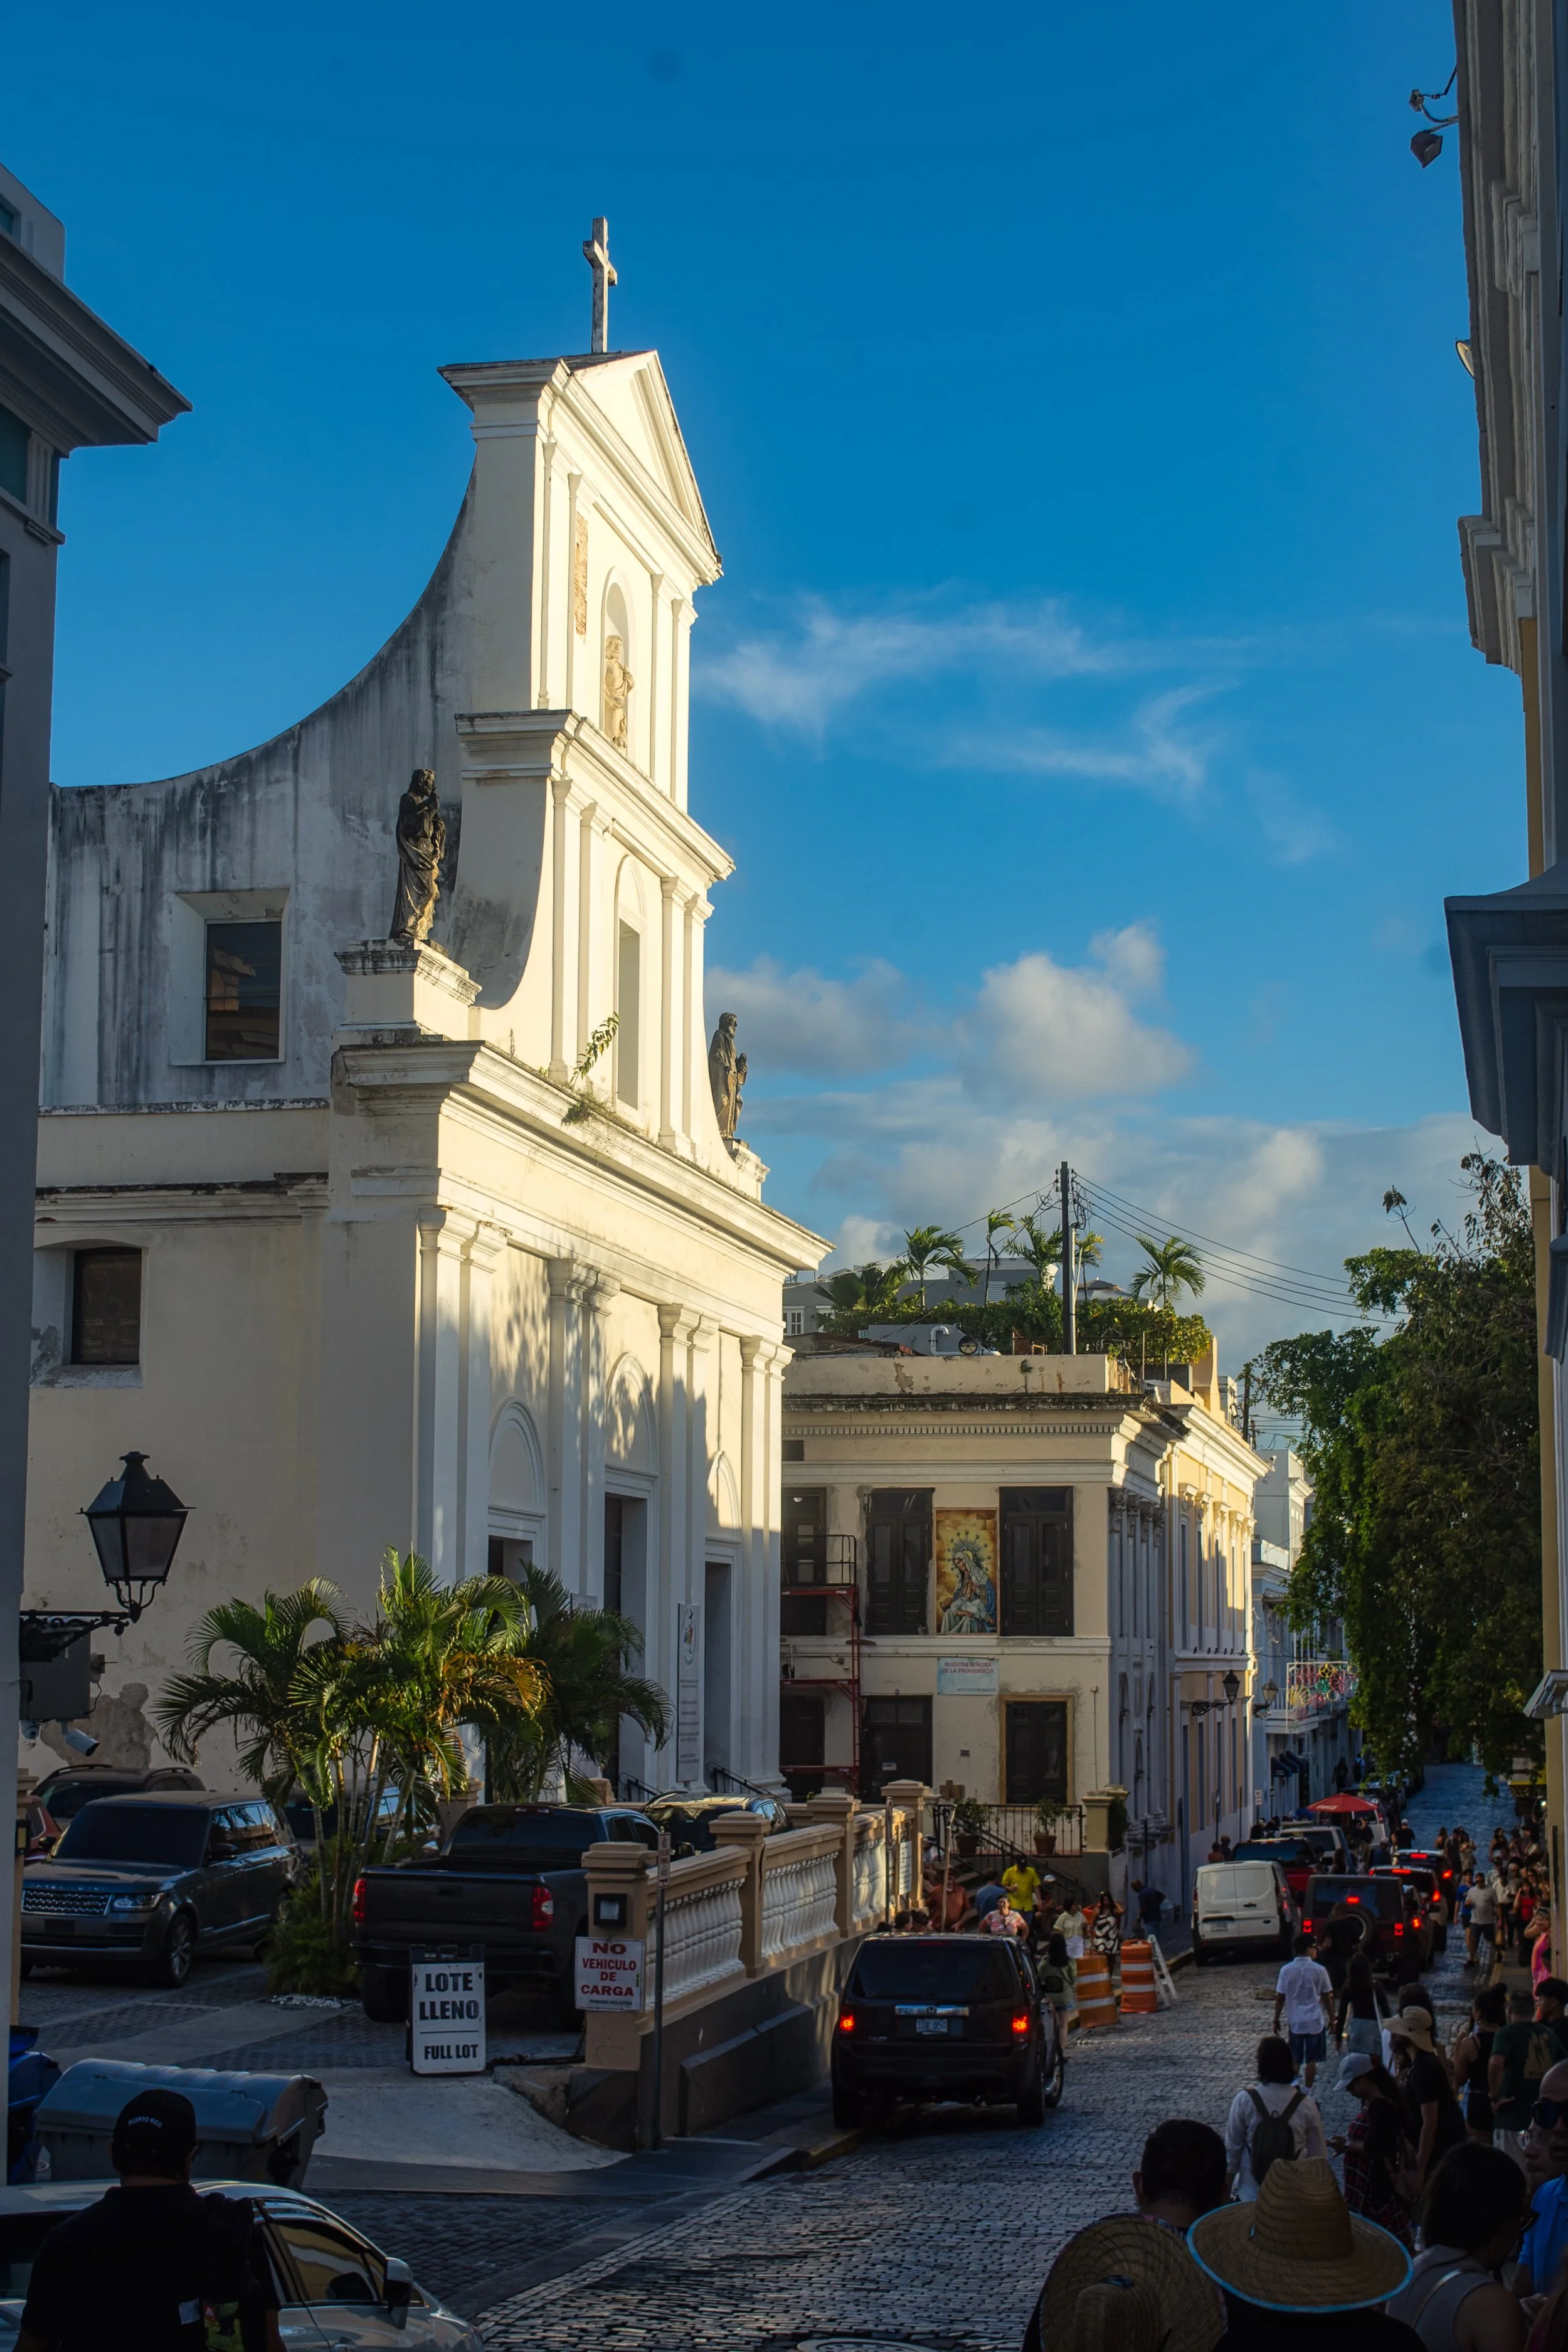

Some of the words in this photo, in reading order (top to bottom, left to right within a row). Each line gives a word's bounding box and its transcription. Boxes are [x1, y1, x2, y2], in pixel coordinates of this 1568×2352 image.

[593, 1942, 627, 1954] NO
[583, 1957, 637, 1971] VEHICULO
[425, 1972, 473, 1992] LOTE
[600, 1971, 617, 1981] DE
[581, 1984, 634, 1996] CARGA
[419, 2000, 479, 2020] LLENO
[425, 2045, 453, 2060] FULL
[456, 2043, 479, 2058] LOT
[128, 2116, 149, 2126] PUERTO
[150, 2117, 163, 2128] RICO
